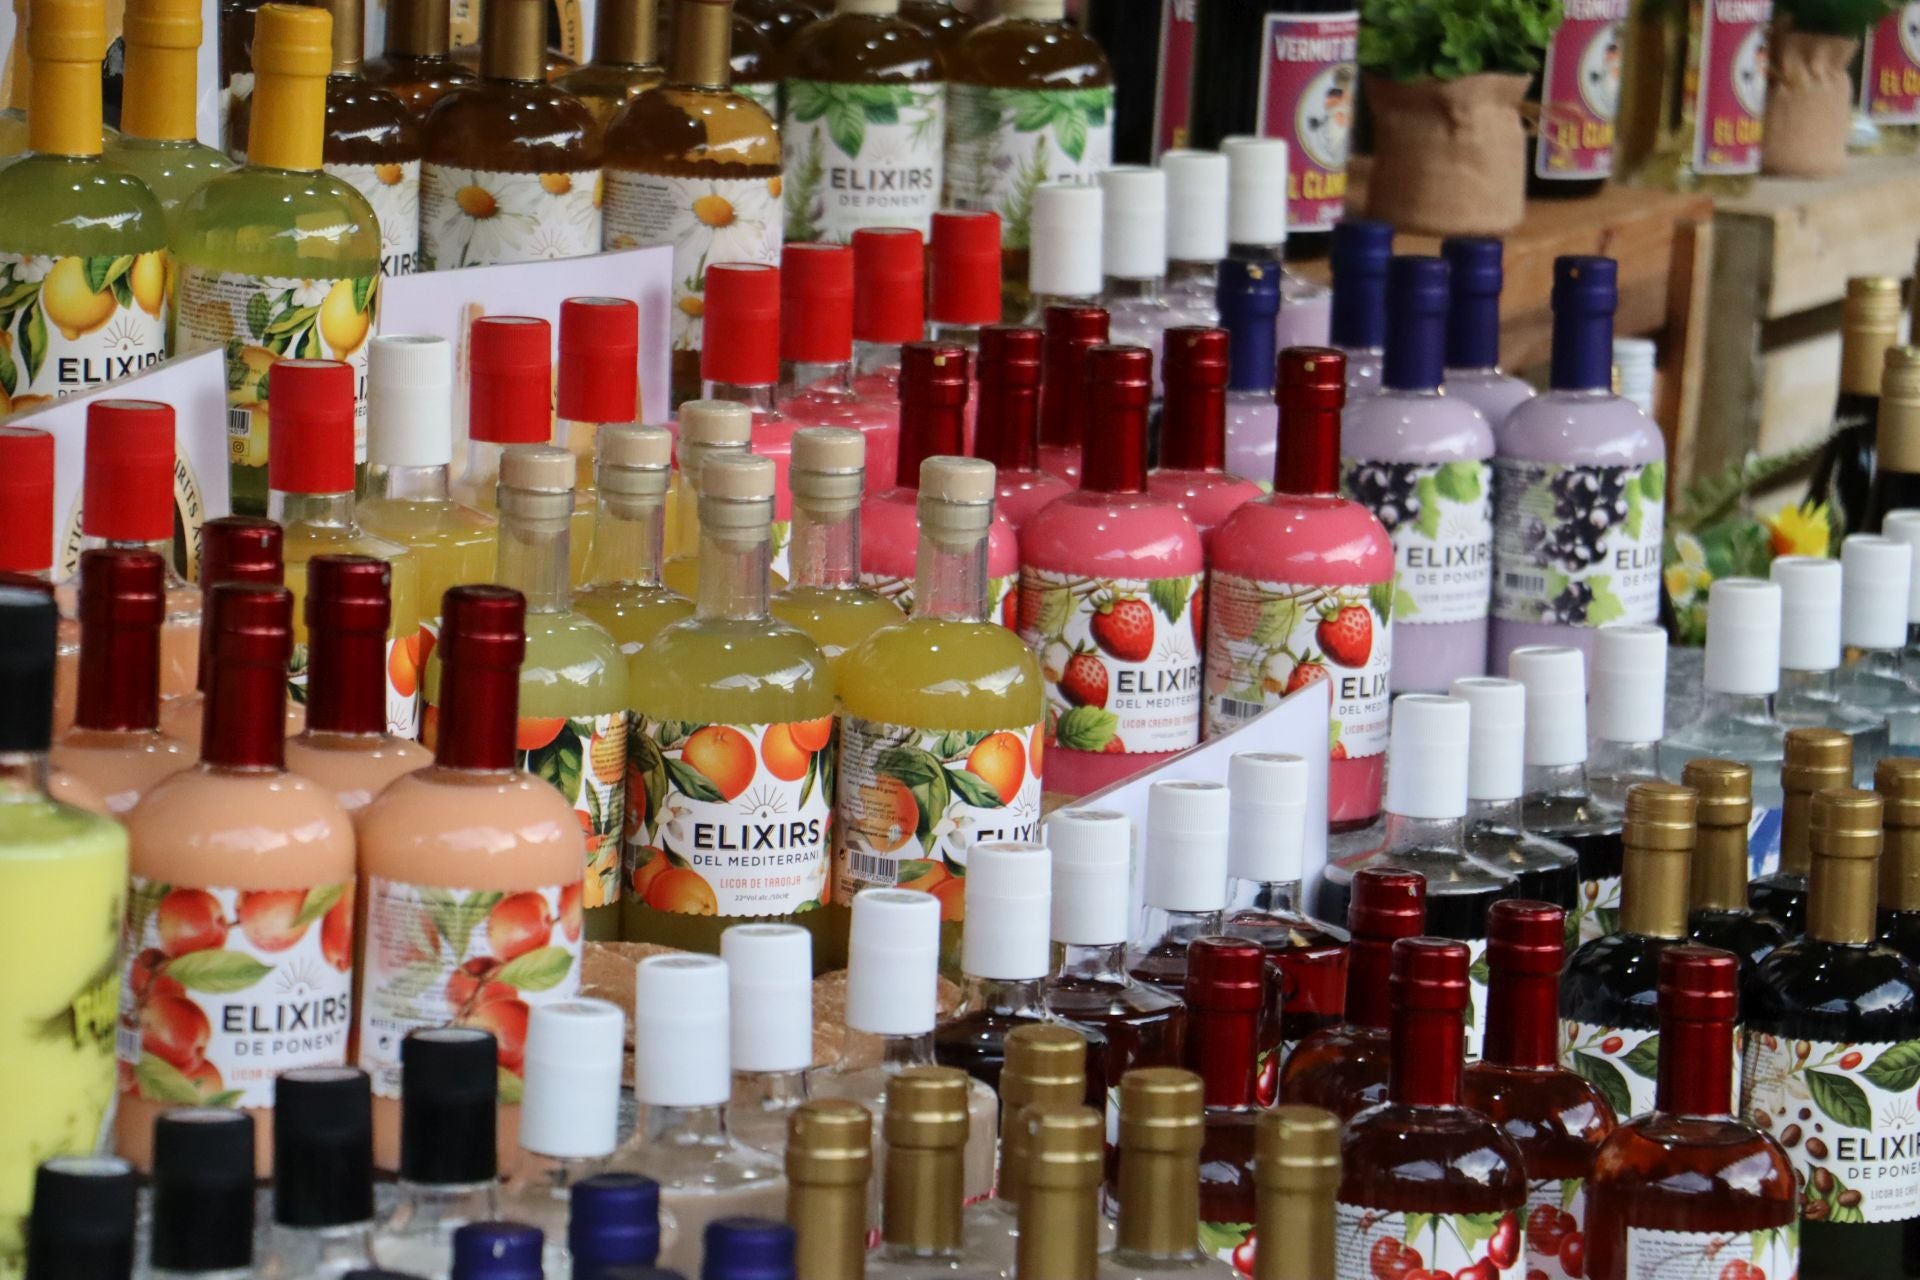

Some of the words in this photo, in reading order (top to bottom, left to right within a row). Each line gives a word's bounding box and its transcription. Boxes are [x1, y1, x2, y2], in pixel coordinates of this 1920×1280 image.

[831, 167, 933, 192] ELIXIRS
[838, 194, 862, 207] DE
[1416, 573, 1438, 586] DE
[1115, 699, 1142, 710] DEL
[1338, 705, 1362, 716] DEL
[694, 818, 820, 851] ELIXIRS
[693, 854, 723, 867] DEL
[720, 877, 748, 889] LICOR
[750, 877, 762, 889] DE
[224, 993, 347, 1033] ELIXIRS
[234, 1041, 264, 1056] DE
[1848, 1167, 1872, 1179] DE
[1878, 1162, 1920, 1178] PONE
